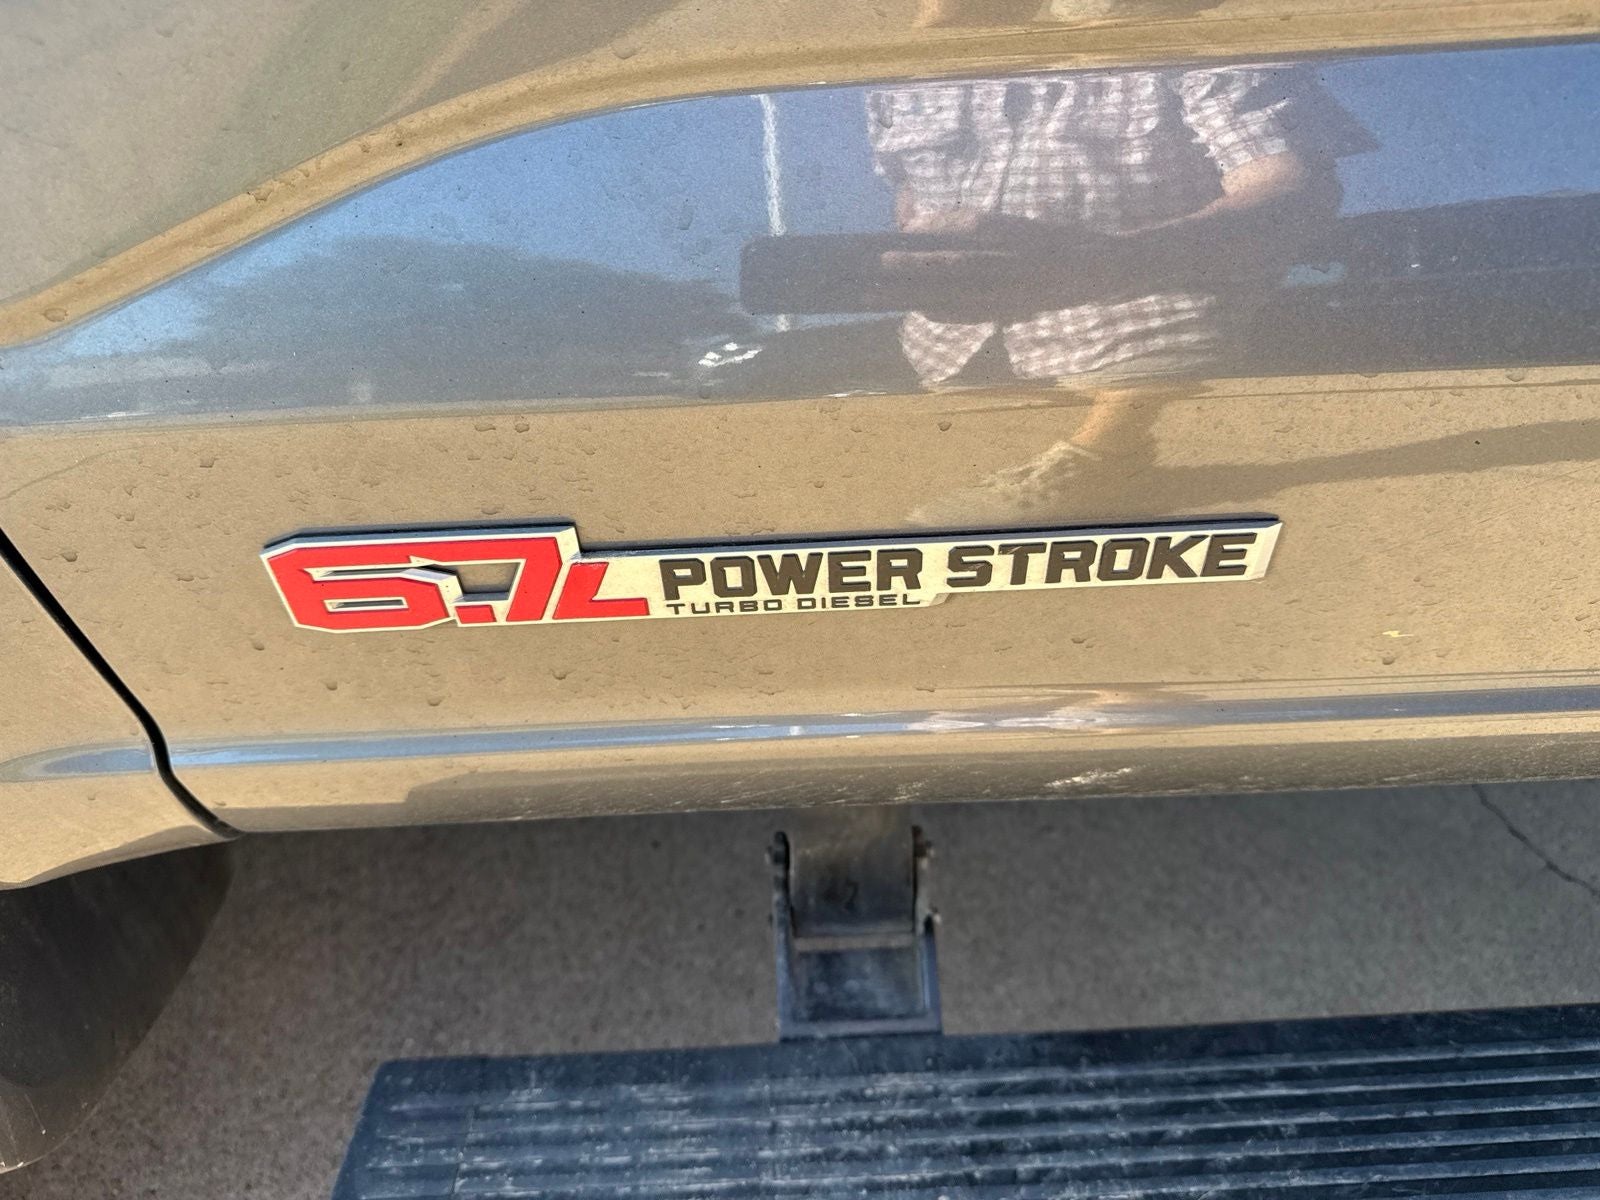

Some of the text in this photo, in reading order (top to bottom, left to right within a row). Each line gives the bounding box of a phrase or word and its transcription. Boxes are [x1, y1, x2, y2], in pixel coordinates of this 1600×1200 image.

[266, 532, 1258, 629] 6.7L POWER STROKE
[666, 593, 921, 615] TURBO DIESEL
